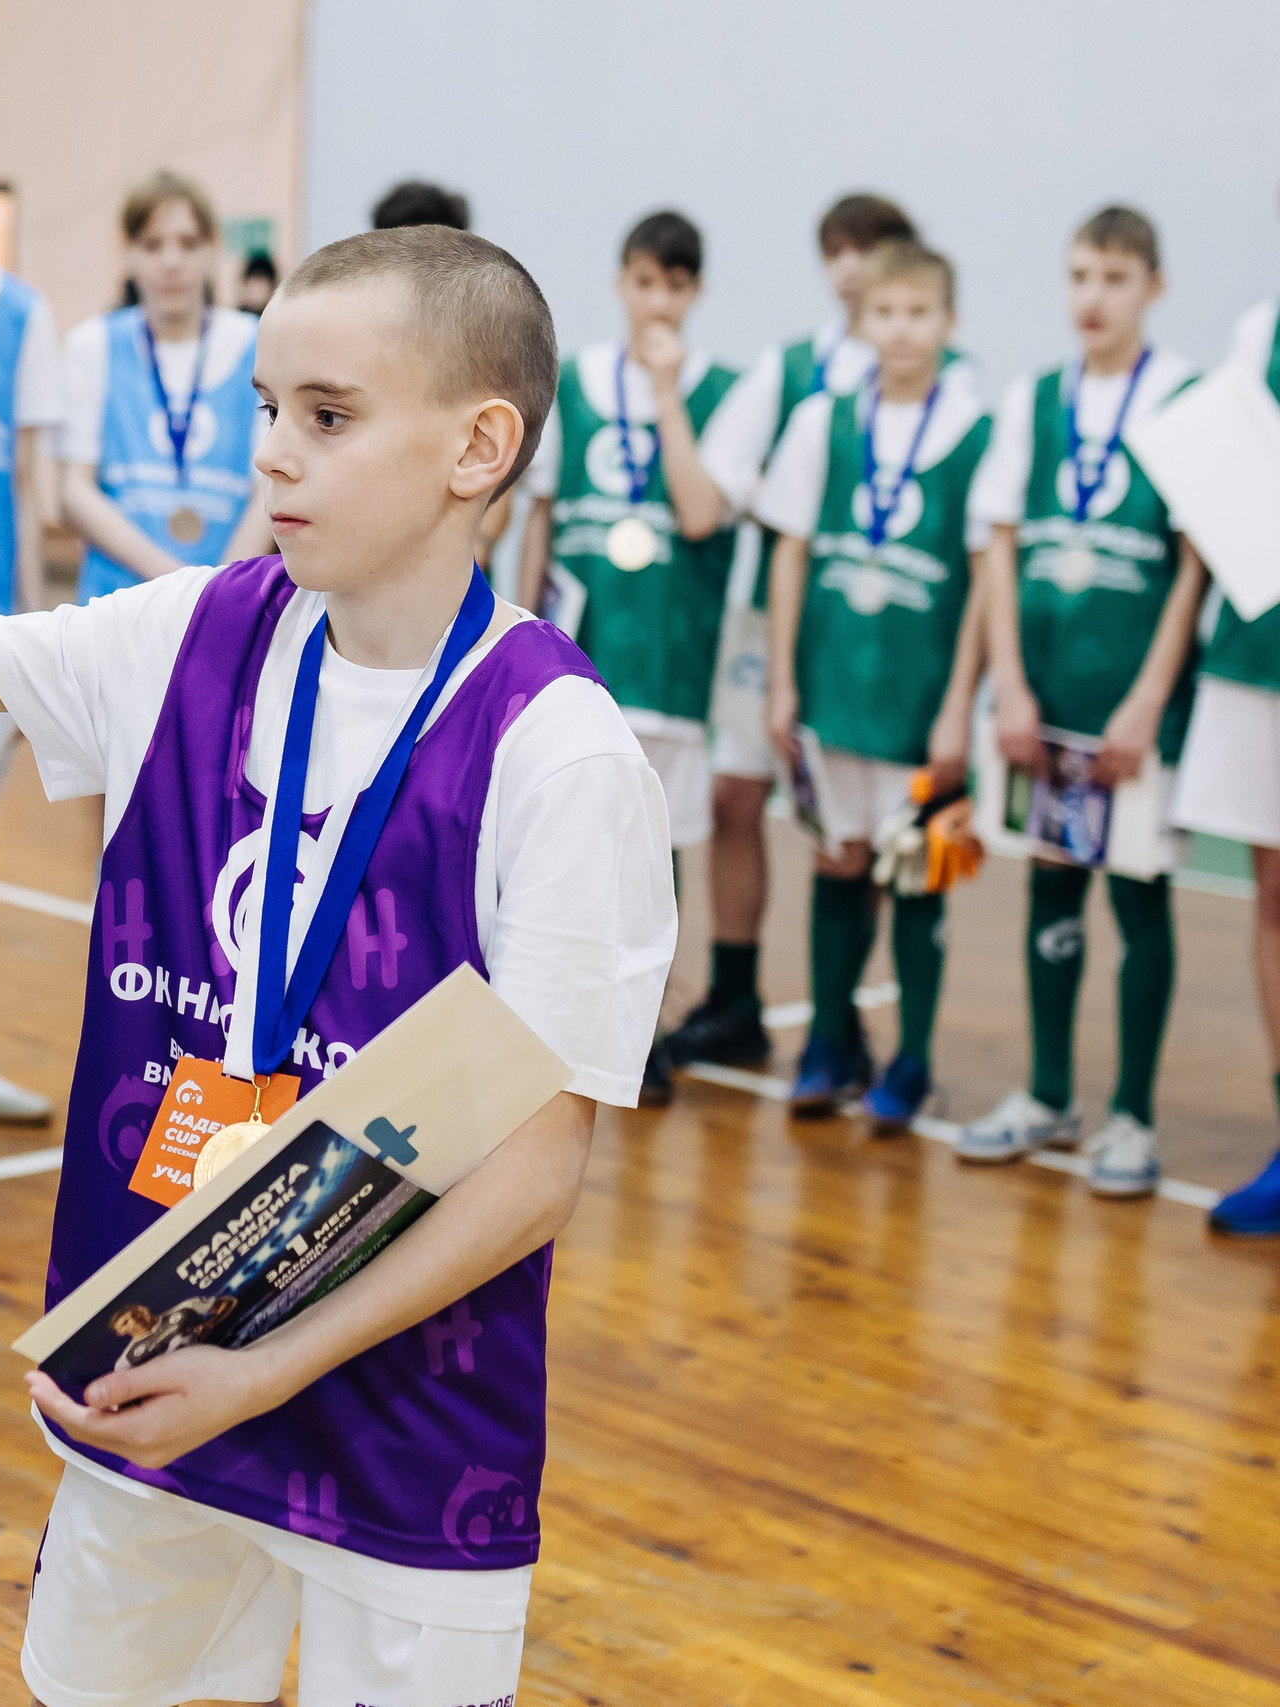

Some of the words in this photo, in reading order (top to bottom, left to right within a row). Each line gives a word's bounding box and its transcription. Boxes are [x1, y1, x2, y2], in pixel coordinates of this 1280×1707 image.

[110, 962, 173, 1008] ФК
[164, 1128, 201, 1146] CUP
[169, 1110, 226, 1135] НАДЕ
[176, 1163, 309, 1280] ГРАМОТА
[189, 1186, 297, 1286] НАДЕЖДИК
[265, 1260, 291, 1284] ЗА
[285, 1233, 309, 1257] 1
[313, 1183, 374, 1241] МЕСТО
[199, 1254, 235, 1289] CUP
